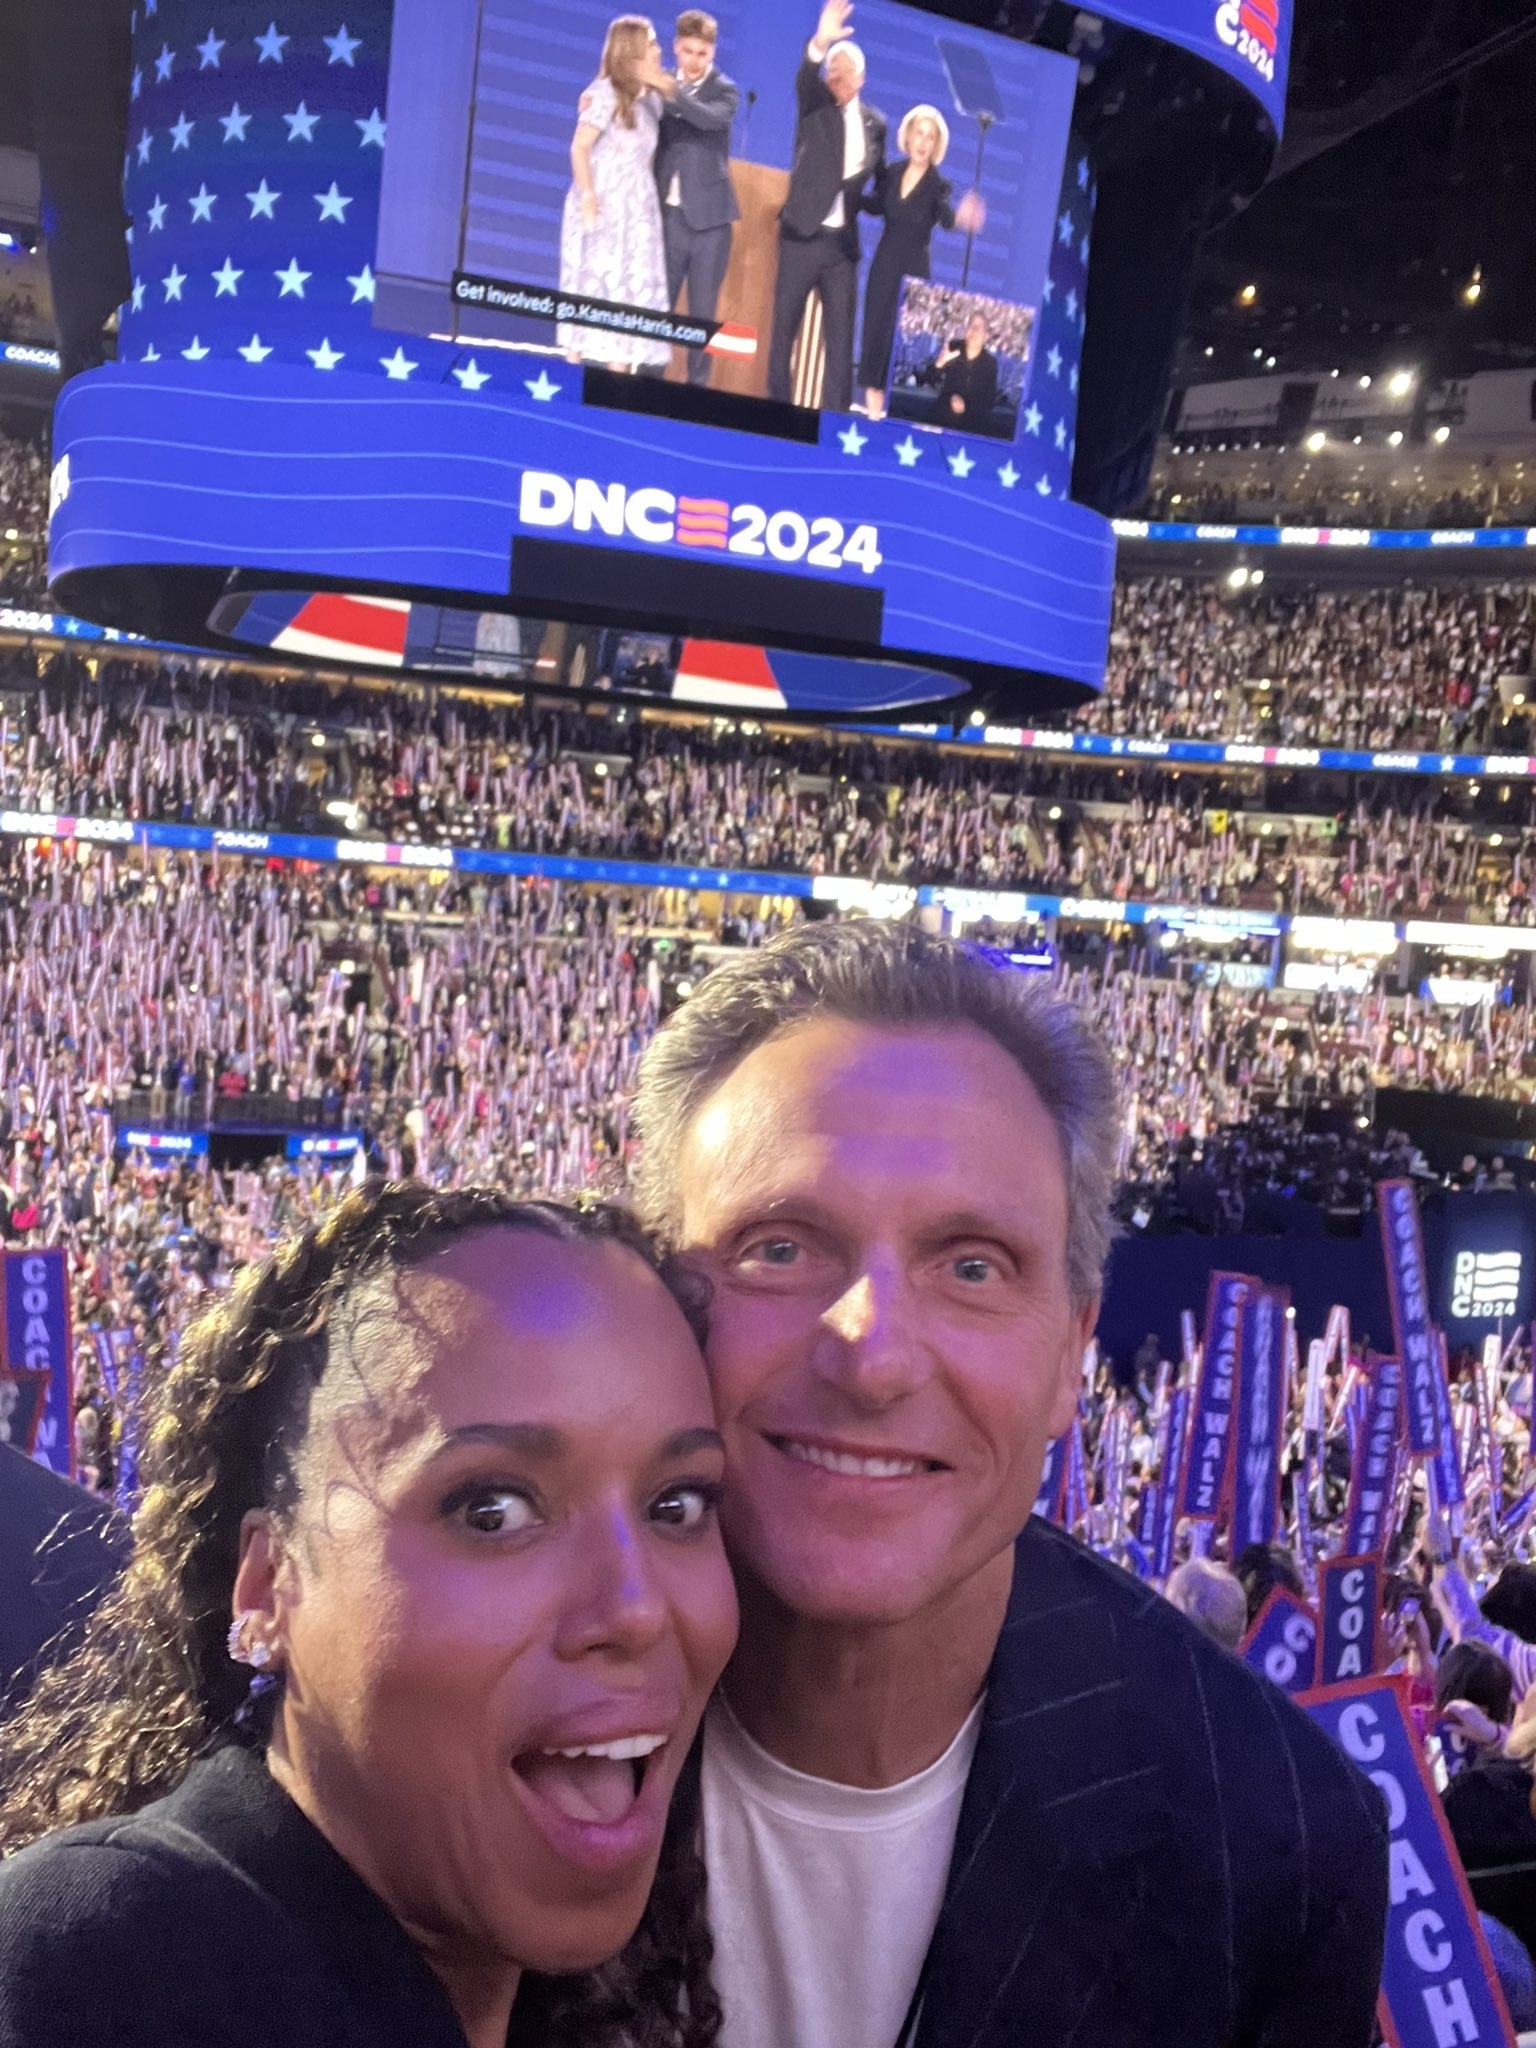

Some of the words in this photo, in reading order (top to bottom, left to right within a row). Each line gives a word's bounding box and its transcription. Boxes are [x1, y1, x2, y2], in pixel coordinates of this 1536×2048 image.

[1237, 28, 1274, 83] 2024
[455, 279, 483, 300] Get
[486, 286, 554, 315] involved:
[556, 300, 707, 344] go.KamalaHarris.com
[519, 470, 676, 543] DNC
[728, 504, 883, 574] 2024
[0, 607, 53, 632] 2024
[75, 816, 135, 842] 2024
[1393, 1185, 1423, 1323] COACH
[1451, 1250, 1475, 1318] DNC
[1471, 1301, 1516, 1317] 2024
[1406, 1332, 1435, 1445] WALZ
[1196, 1411, 1230, 1508] WALZ
